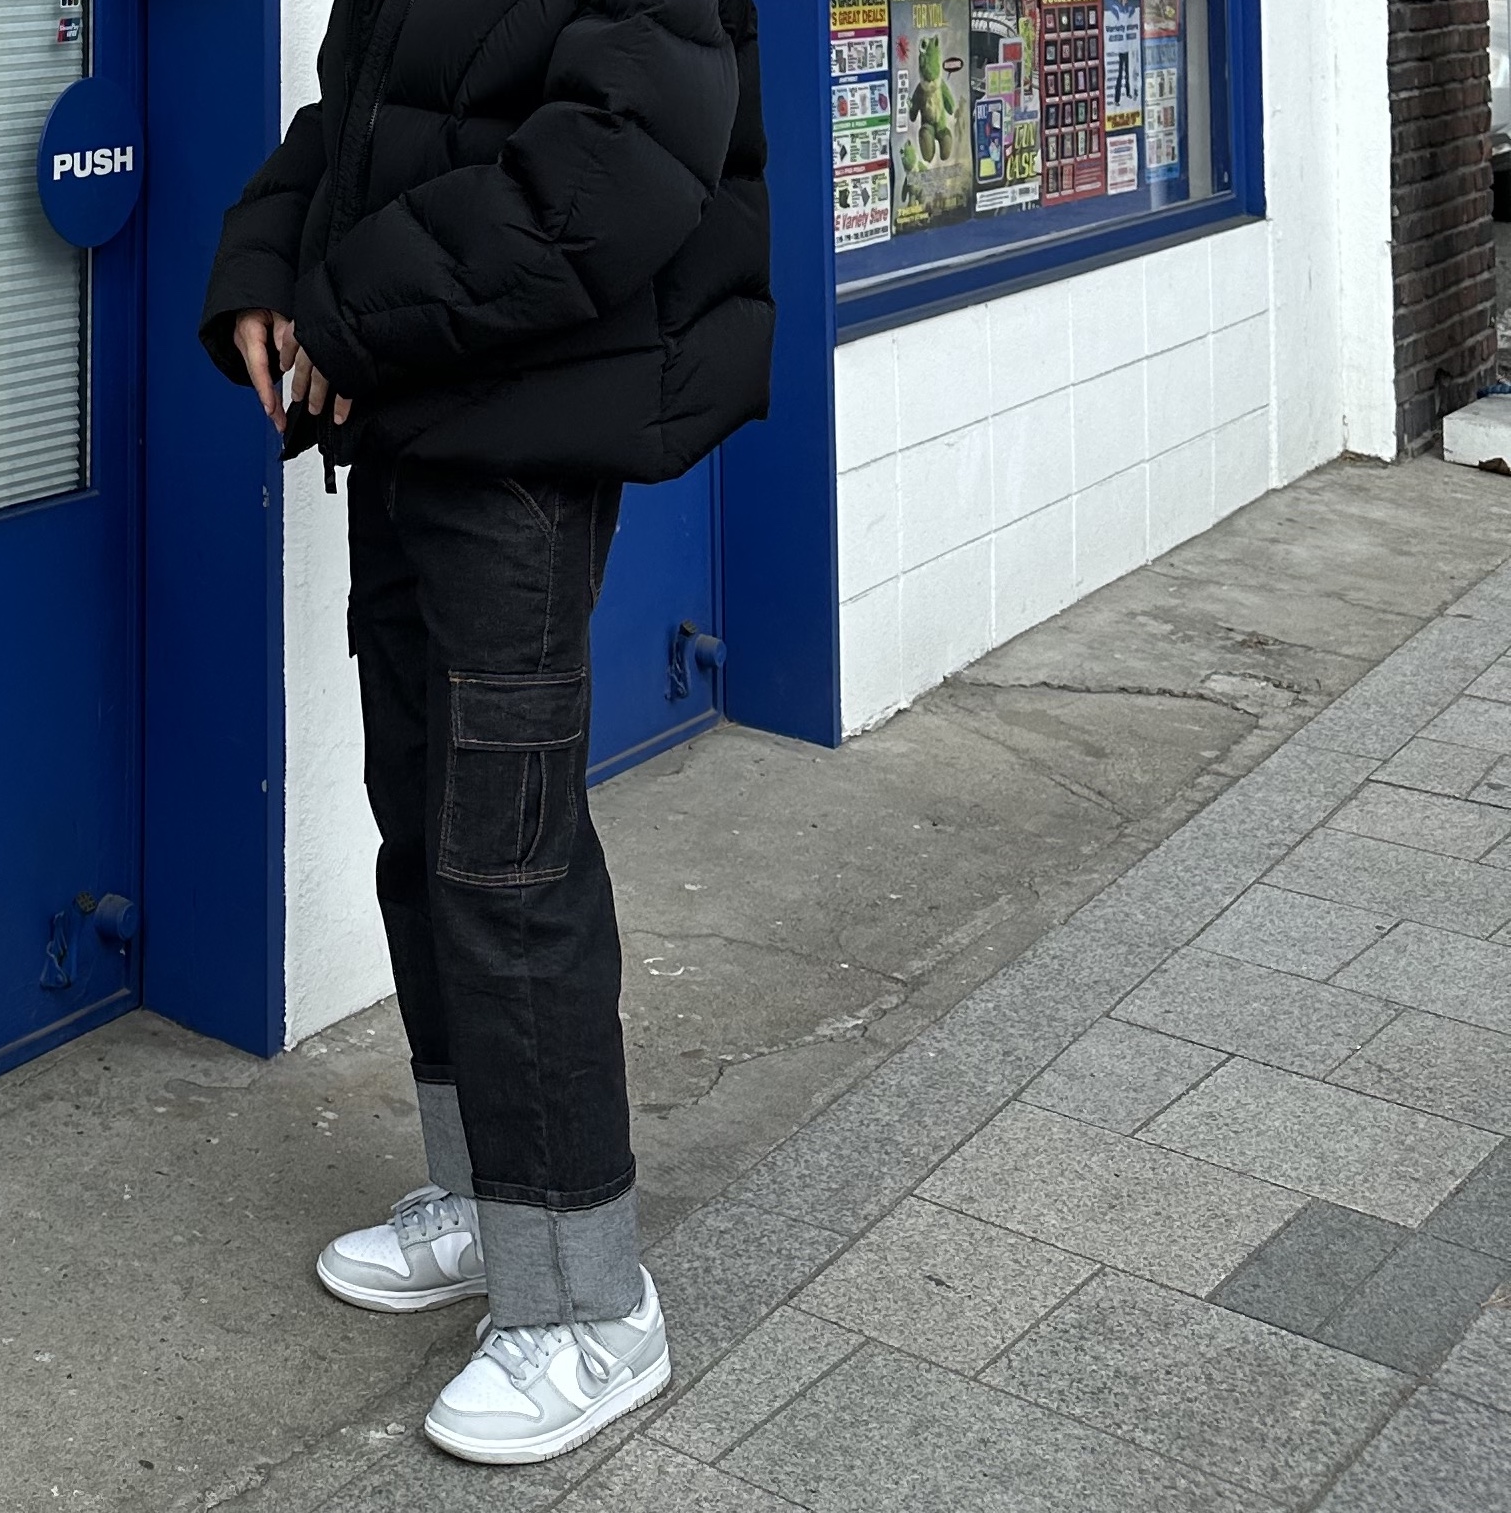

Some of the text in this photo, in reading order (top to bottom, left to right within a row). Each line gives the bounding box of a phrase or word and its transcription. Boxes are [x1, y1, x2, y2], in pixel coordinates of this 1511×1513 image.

[838, 9, 860, 26] GREAT
[53, 146, 134, 181] PUSH
[842, 208, 869, 230] Variety
[869, 207, 888, 224] Store
